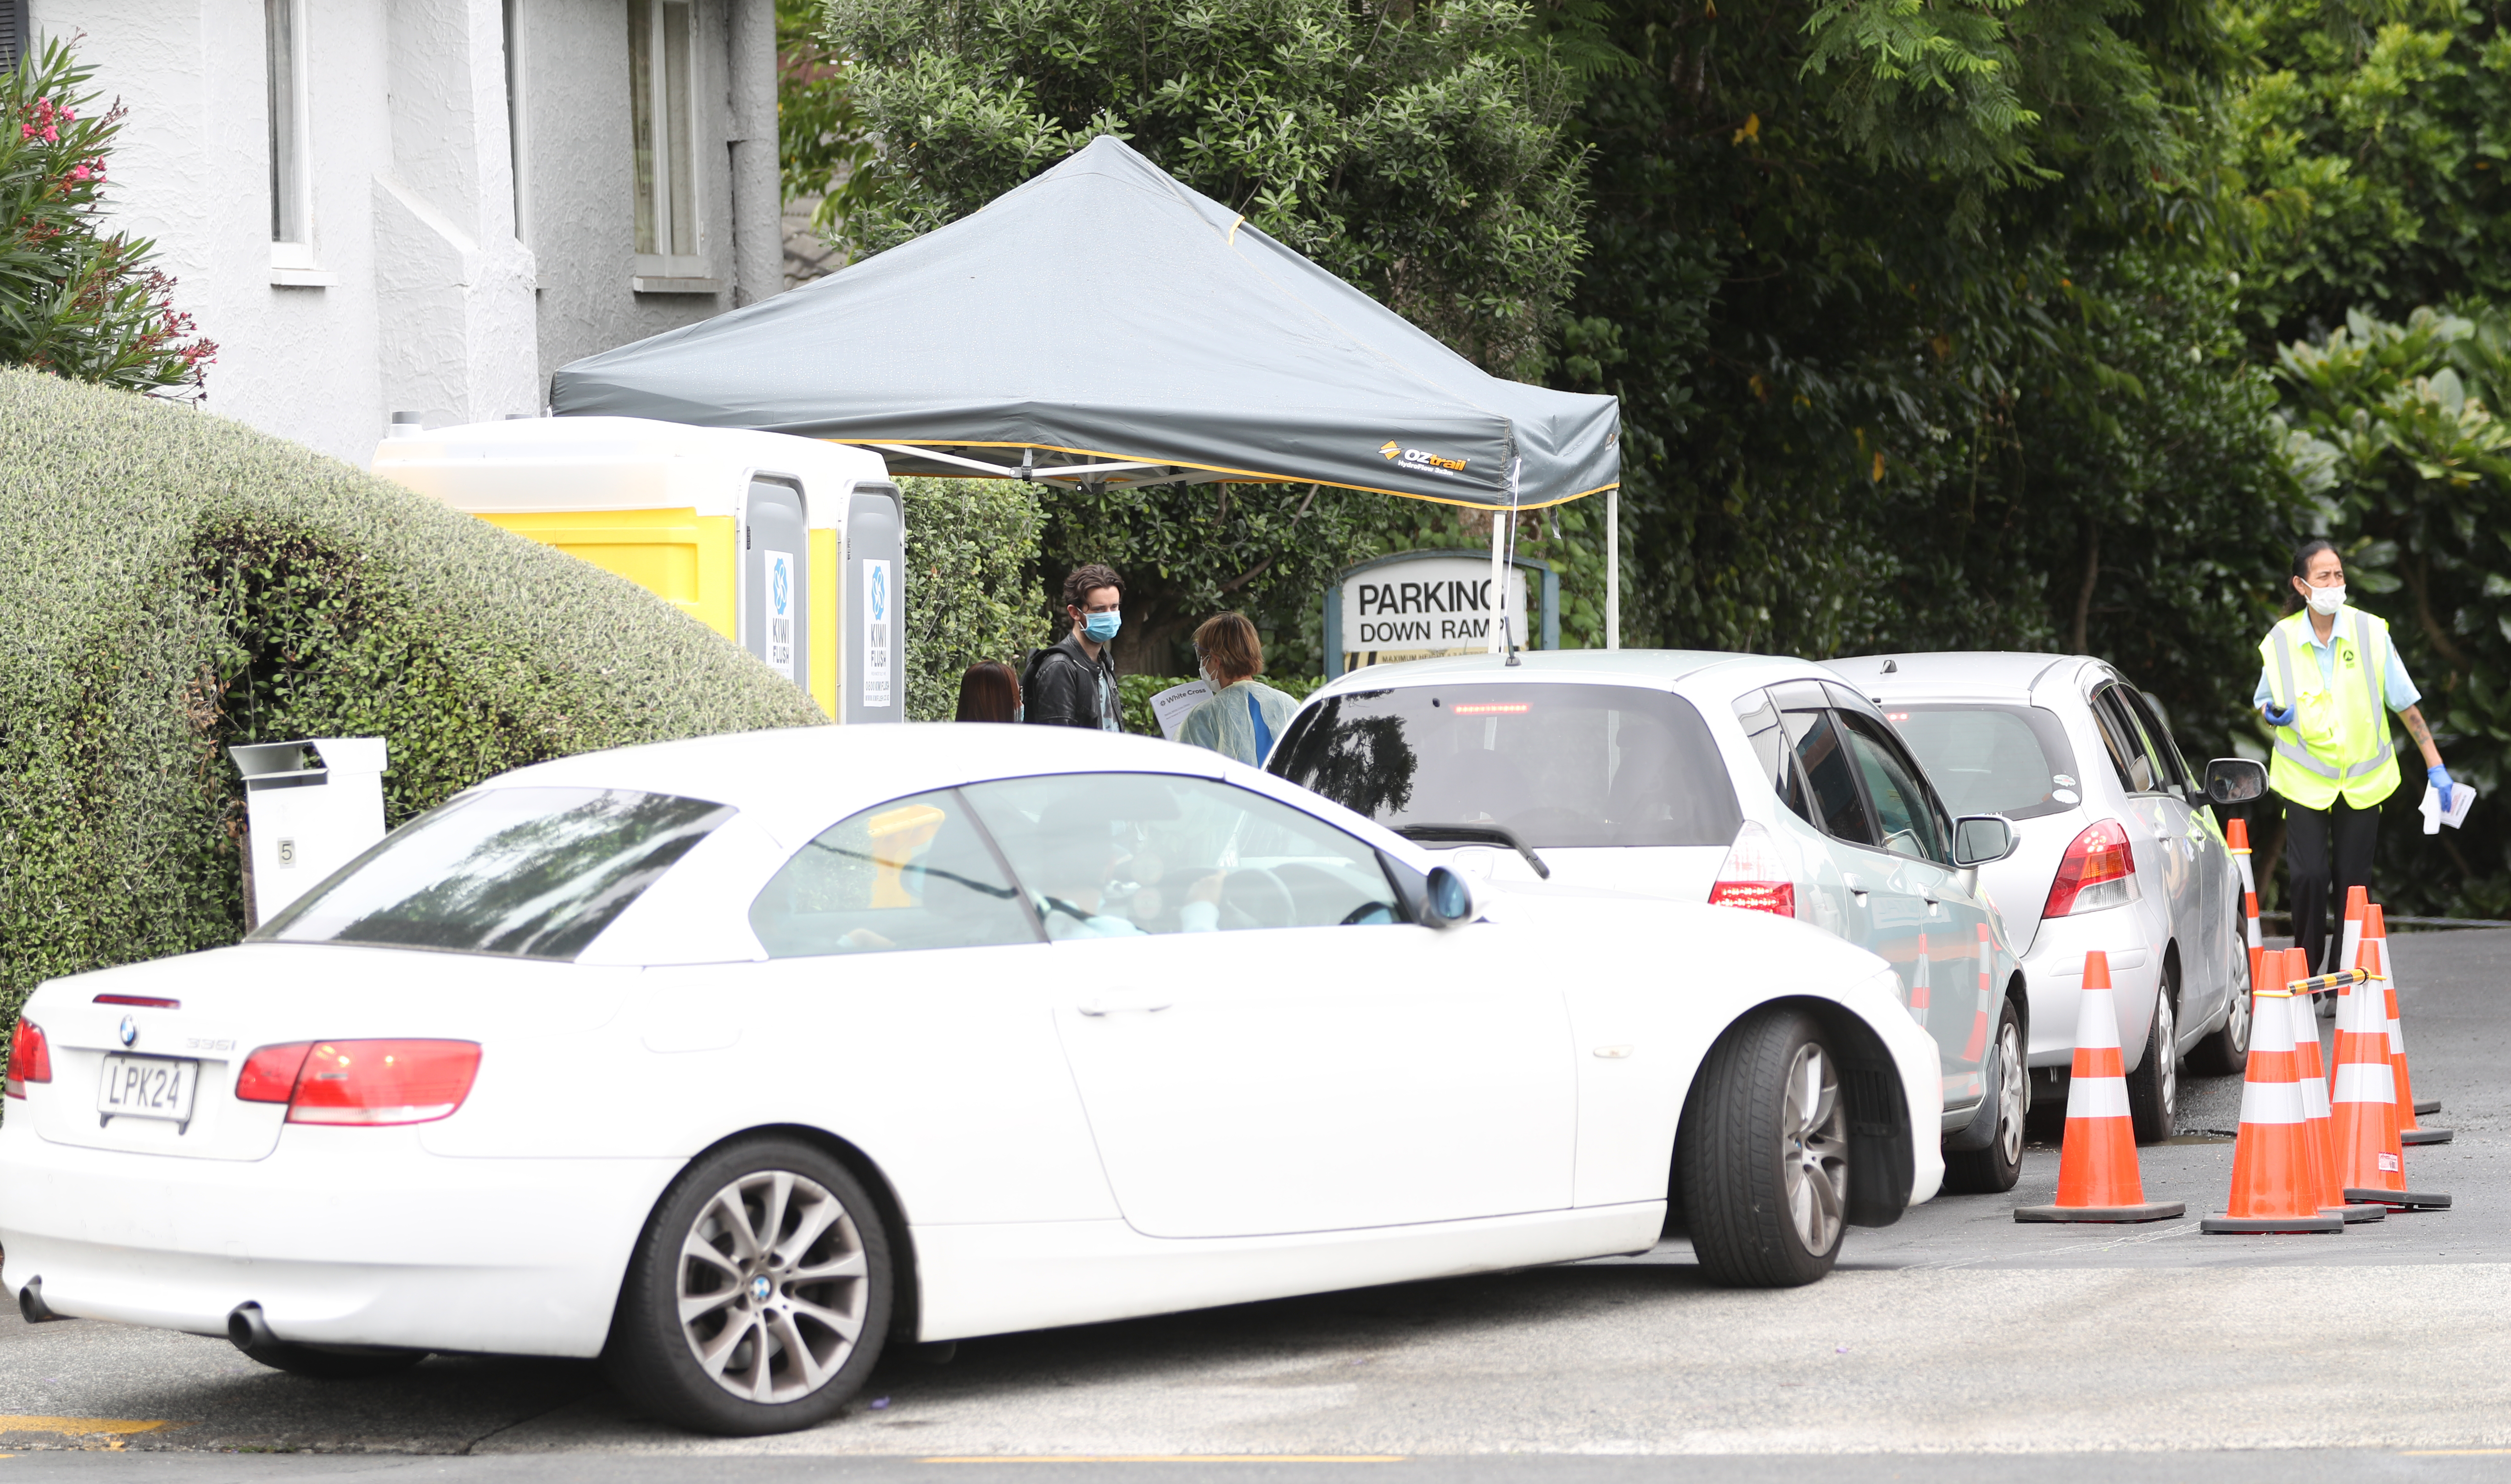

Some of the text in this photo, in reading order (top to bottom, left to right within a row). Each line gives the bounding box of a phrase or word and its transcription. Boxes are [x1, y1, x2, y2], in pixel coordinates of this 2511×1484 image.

[1398, 460, 1454, 476] HydroFlow 3x3m
[1404, 448, 1467, 472] OZtrail
[773, 617, 789, 644] KIWI
[871, 623, 887, 648] KIWI
[1361, 620, 1432, 643] DOWN
[773, 645, 789, 664] FLUSH
[871, 650, 887, 667] FLUSH
[1166, 693, 1187, 703] White
[281, 844, 292, 861] 5
[110, 1065, 181, 1109] LPK24
